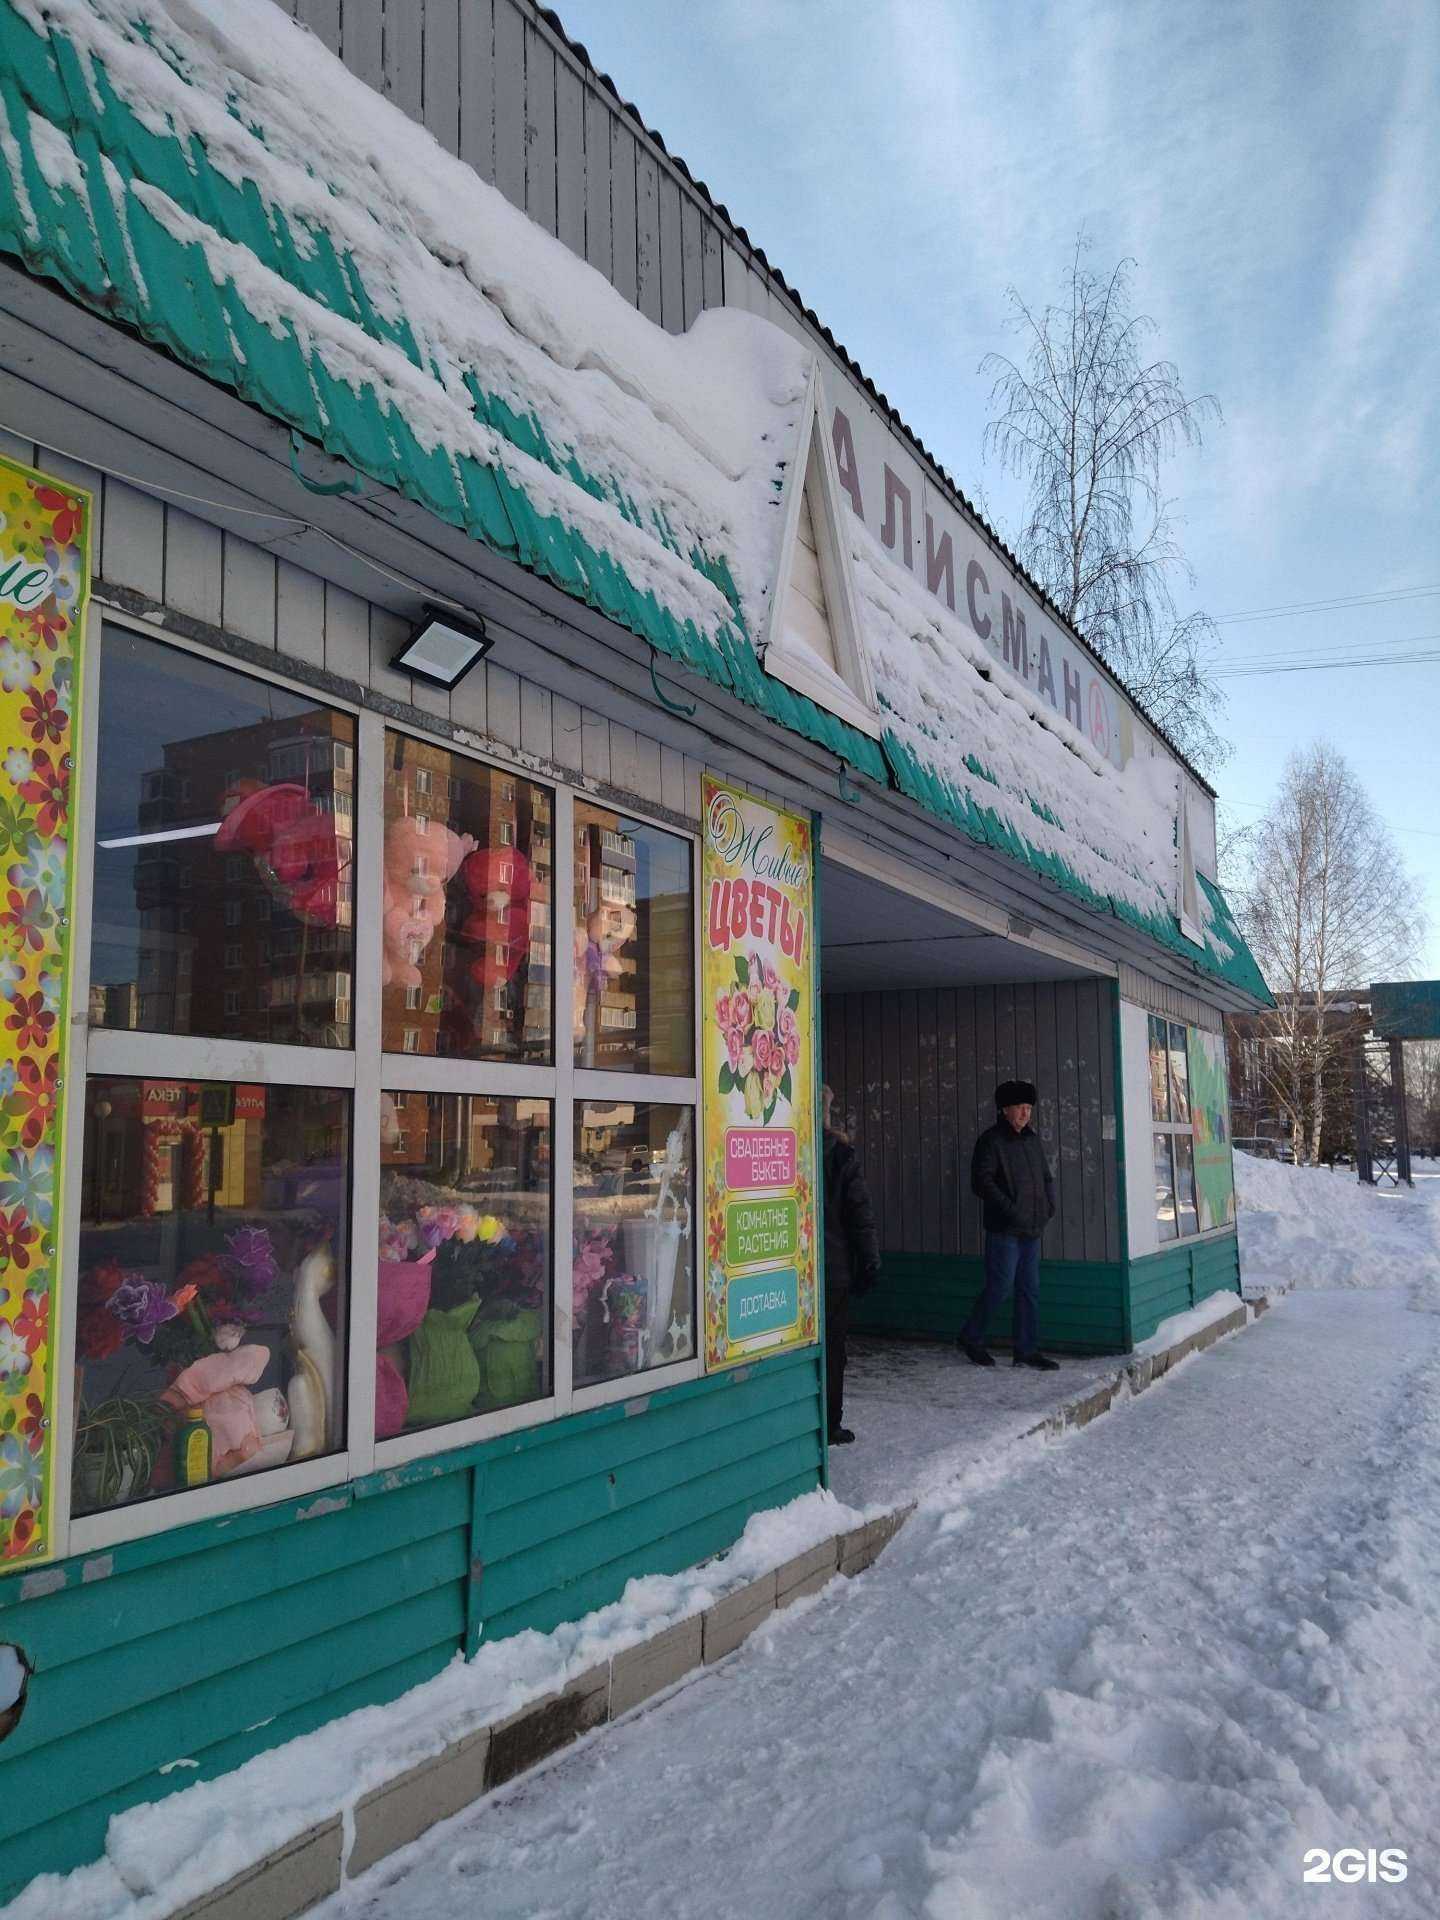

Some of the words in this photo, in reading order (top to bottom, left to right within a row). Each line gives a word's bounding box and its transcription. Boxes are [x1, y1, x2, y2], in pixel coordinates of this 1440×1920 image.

[709, 878, 804, 966] ЦВЕТЫ
[730, 1136, 790, 1159] СВАДЕБНЫЕ
[751, 1159, 790, 1182] БУКЕТЫ
[736, 1206, 789, 1229] КОМНАТНЫЕ
[738, 1230, 789, 1256] РАСТЕНИЯ
[739, 1291, 787, 1320] ДОСТАВКА
